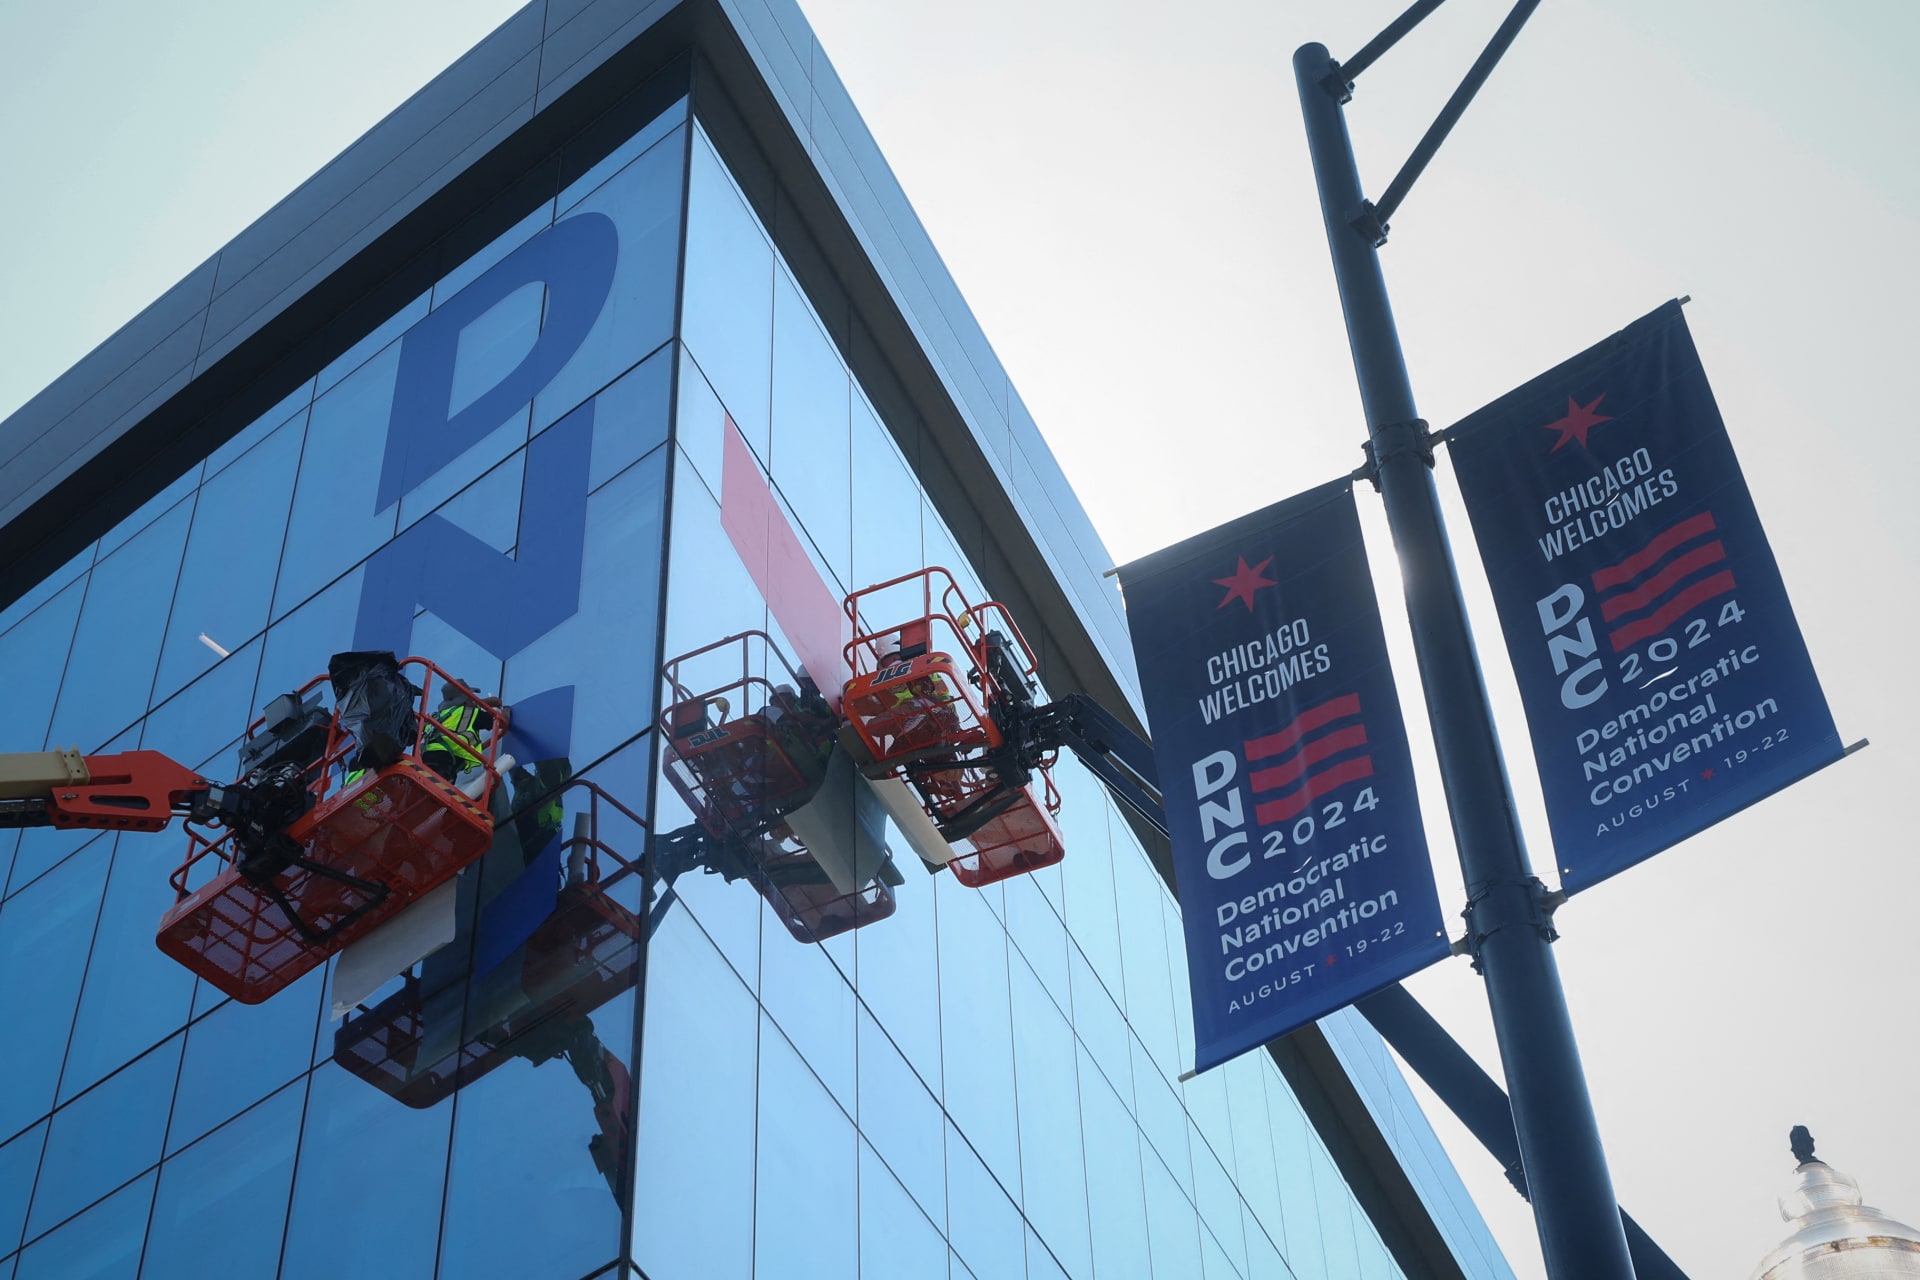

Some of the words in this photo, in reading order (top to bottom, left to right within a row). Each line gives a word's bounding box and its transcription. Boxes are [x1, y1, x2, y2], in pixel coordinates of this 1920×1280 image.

[1537, 468, 1679, 563] WELCOMES
[1543, 447, 1653, 526] CHICAGO
[869, 660, 913, 687] JLG
[1198, 643, 1332, 725] WELCOMES
[1206, 617, 1310, 685] CHICAGO
[1536, 582, 1609, 710] DNC
[1619, 599, 1747, 685] 2024
[1575, 643, 1761, 756] Democratic
[1582, 694, 1718, 782] National
[1589, 698, 1779, 807] Convention
[1595, 780, 1691, 838] AUGUST
[1723, 727, 1790, 770] 19-22
[1191, 749, 1252, 880] DNC
[1261, 786, 1381, 860] 2024
[1216, 832, 1389, 927] Democratic
[1220, 878, 1346, 954] National
[1224, 888, 1399, 982] Convention
[1227, 964, 1317, 1015] AUGUST
[1345, 921, 1406, 958] 19-22
